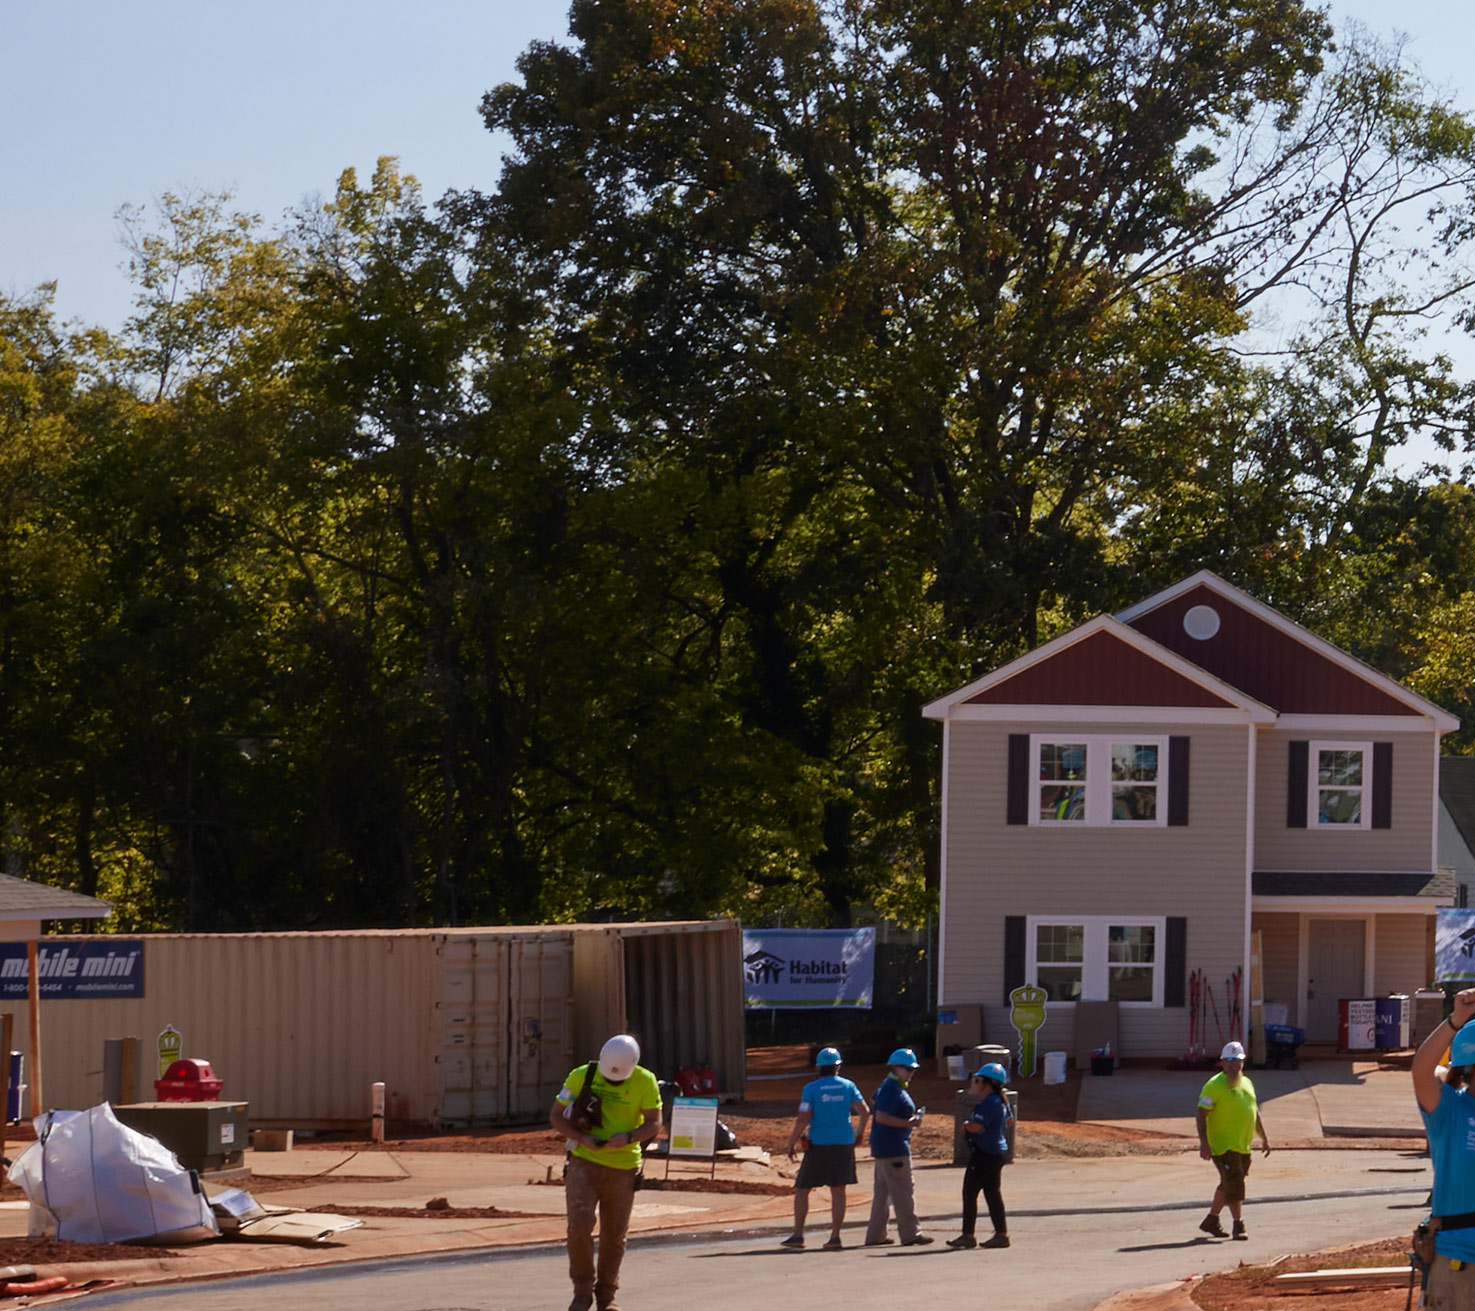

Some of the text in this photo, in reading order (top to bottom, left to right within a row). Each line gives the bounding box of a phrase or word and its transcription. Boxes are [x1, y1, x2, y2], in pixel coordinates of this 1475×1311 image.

[1, 948, 138, 977] mobile mini
[790, 960, 848, 975] Habitat
[805, 976, 847, 985] Humanity
